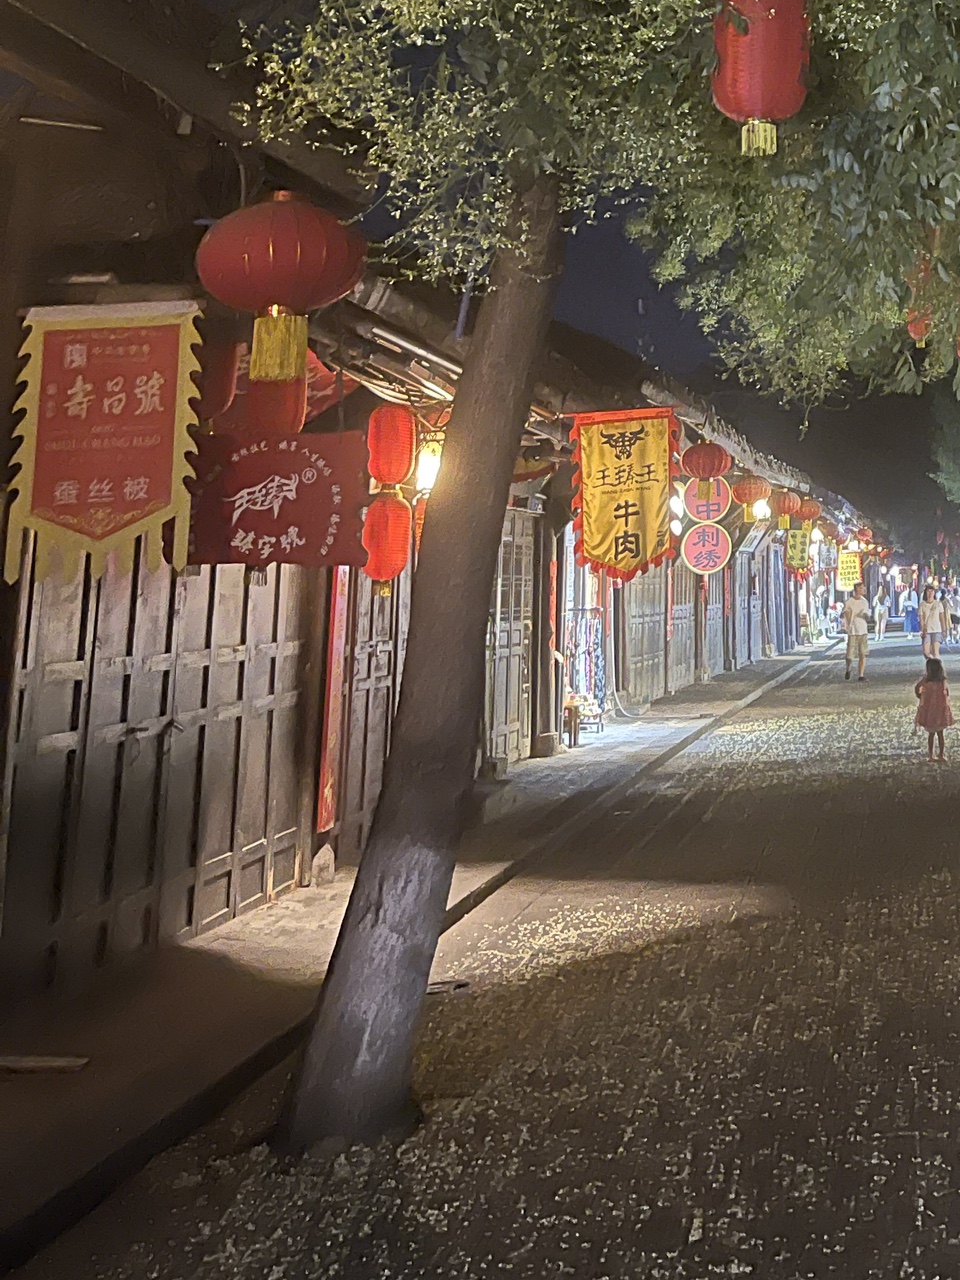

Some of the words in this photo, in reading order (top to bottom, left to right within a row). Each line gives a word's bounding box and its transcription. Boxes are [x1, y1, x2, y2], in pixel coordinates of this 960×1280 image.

[54, 476, 150, 506] 蚕丝被
[613, 499, 641, 561] 牛肉
[693, 527, 721, 569] 刺绣
